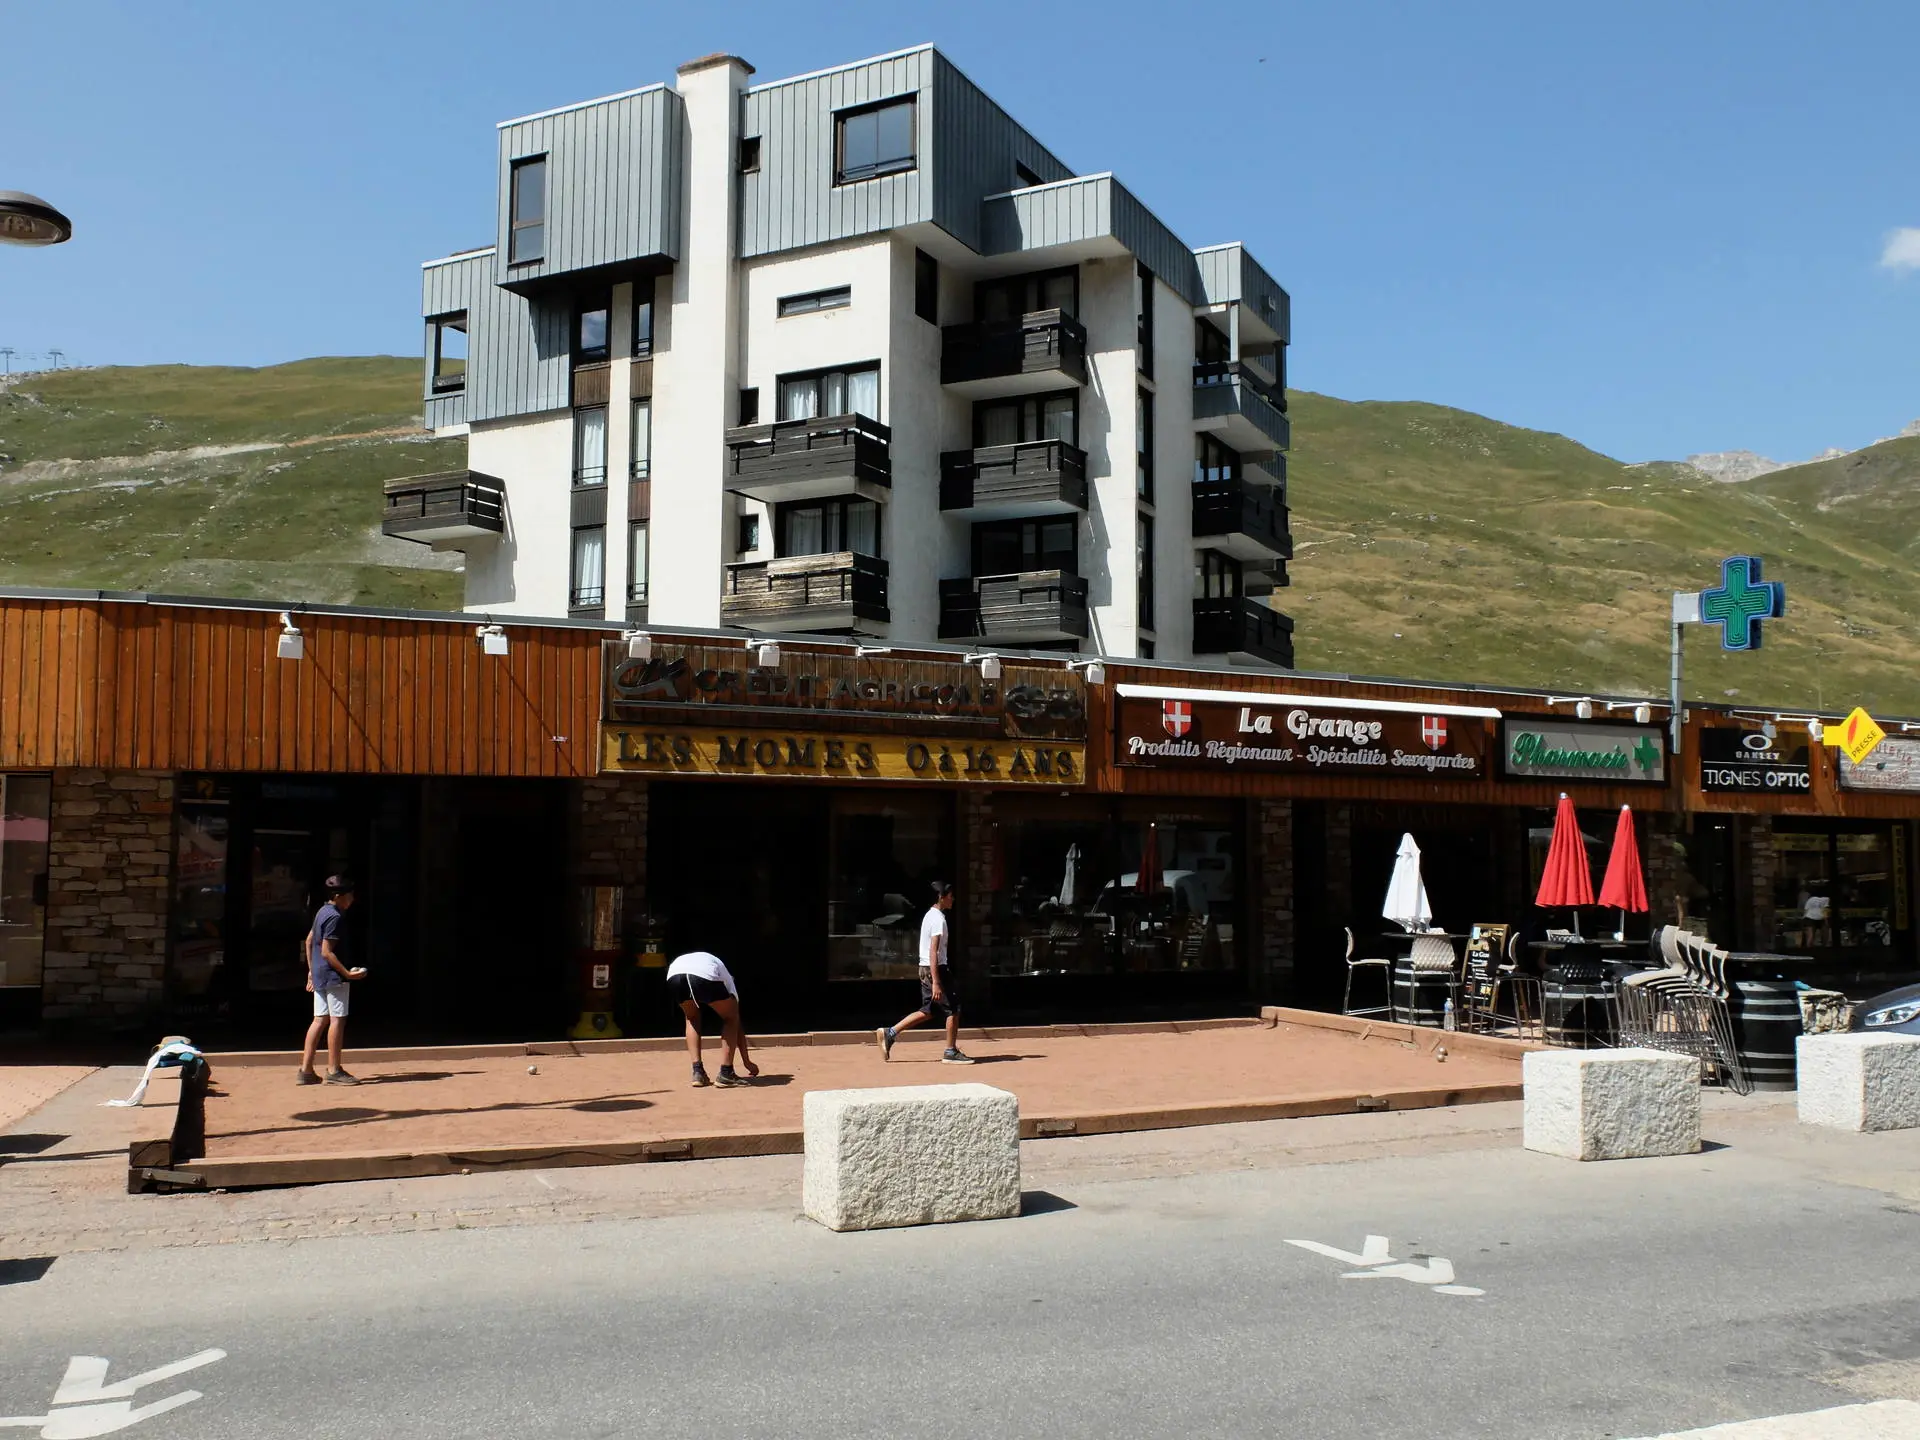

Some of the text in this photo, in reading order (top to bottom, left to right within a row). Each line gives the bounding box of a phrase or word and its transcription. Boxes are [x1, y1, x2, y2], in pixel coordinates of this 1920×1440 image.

[828, 680, 997, 706] AGRICOLE
[1239, 707, 1382, 745] La Grange
[617, 732, 692, 765] LES
[715, 736, 874, 770] MOMES
[1009, 746, 1073, 777] ANS
[1128, 736, 1201, 757] Produits
[1205, 740, 1293, 764] Régionaux
[1306, 745, 1388, 767] Spécialités
[1391, 749, 1476, 772] Savoyardes
[1511, 732, 1629, 769] Pharmacie
[1735, 751, 1780, 761] OAKLEY
[1851, 730, 1878, 758] PRESSE
[1703, 769, 1810, 788] TIGNES OPTIC
